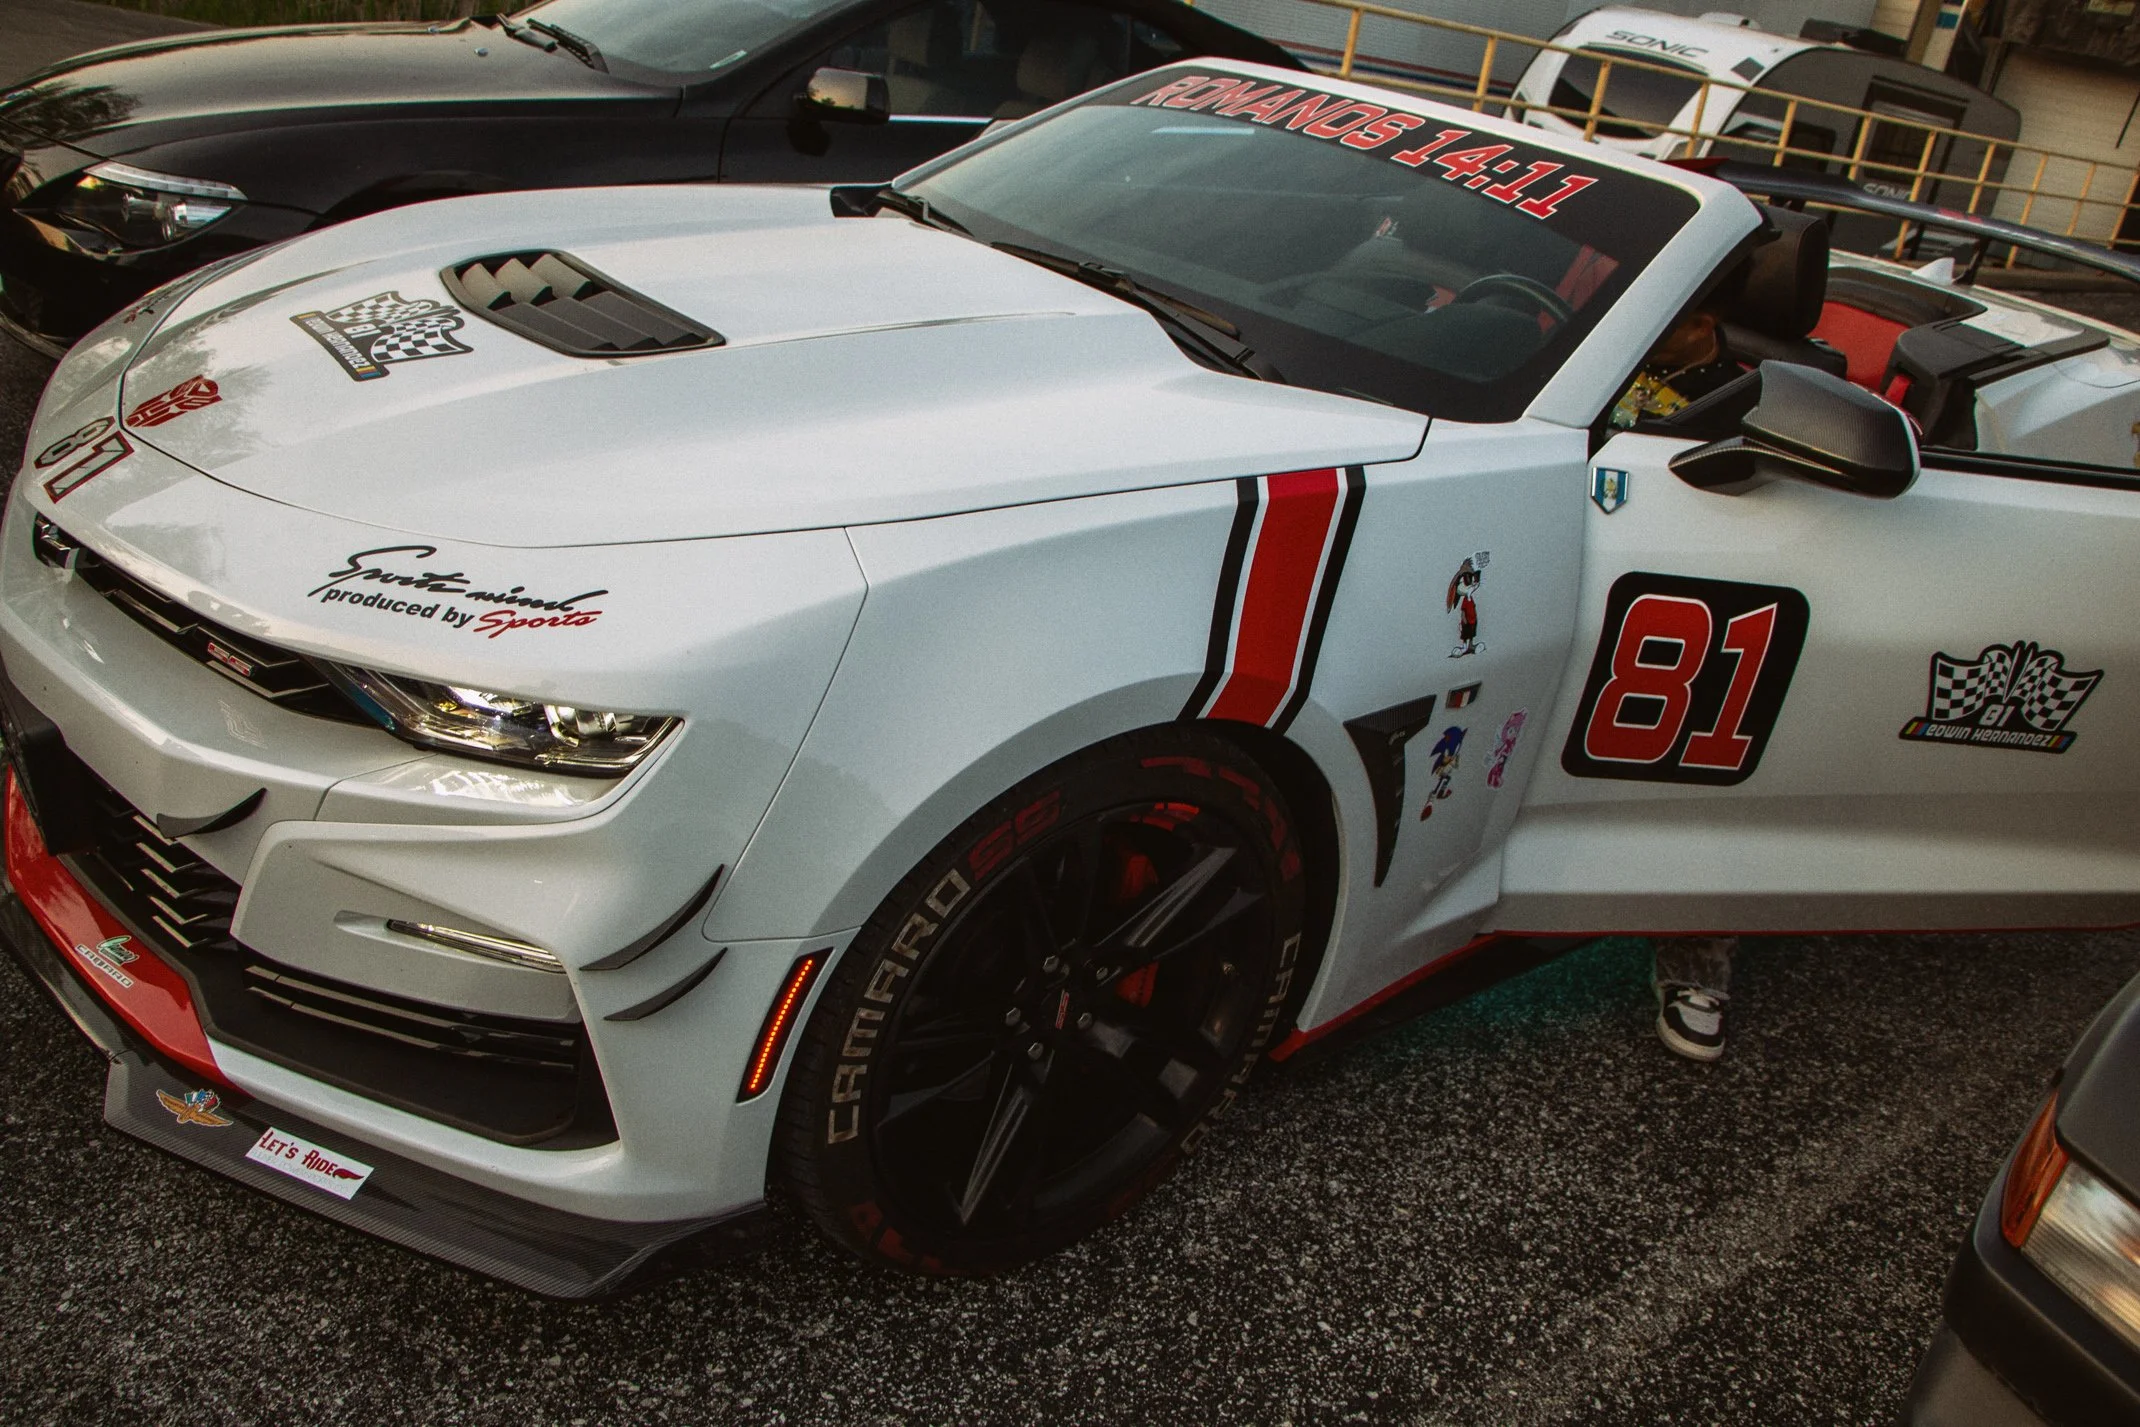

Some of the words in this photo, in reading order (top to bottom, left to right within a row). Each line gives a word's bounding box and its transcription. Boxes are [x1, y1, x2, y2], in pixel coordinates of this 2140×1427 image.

[1605, 30, 1709, 58] SONIC
[1131, 75, 1426, 151] ROMANOS
[1391, 129, 1600, 221] 14:11
[343, 322, 383, 340] 81
[320, 587, 442, 620] produced
[440, 606, 475, 629] by
[473, 609, 603, 639] Sports
[1584, 593, 1779, 771] 81
[1979, 704, 2017, 728] 81
[827, 868, 971, 1146] CAMARO
[967, 789, 1062, 881] SS
